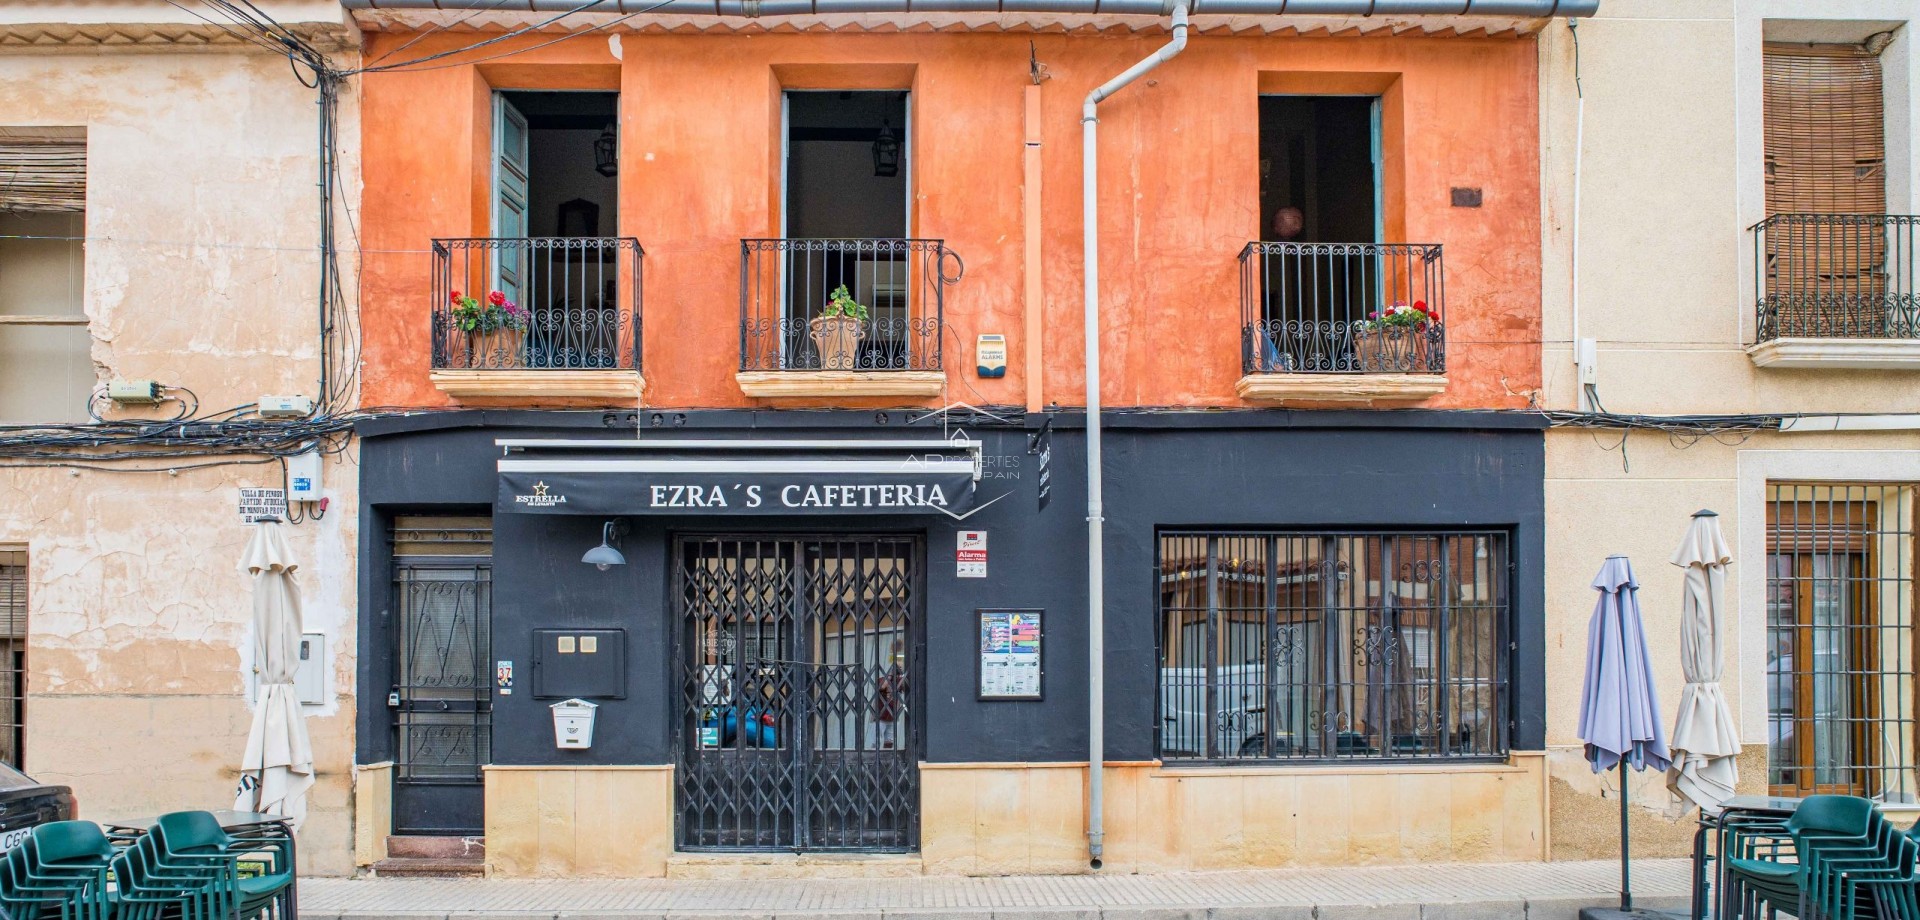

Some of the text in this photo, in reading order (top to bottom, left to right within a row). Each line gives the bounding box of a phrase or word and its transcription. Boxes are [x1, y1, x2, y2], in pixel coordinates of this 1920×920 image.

[516, 495, 567, 503] ESTRELLA
[781, 484, 948, 508] CAFETERIA
[499, 667, 511, 678] 37
